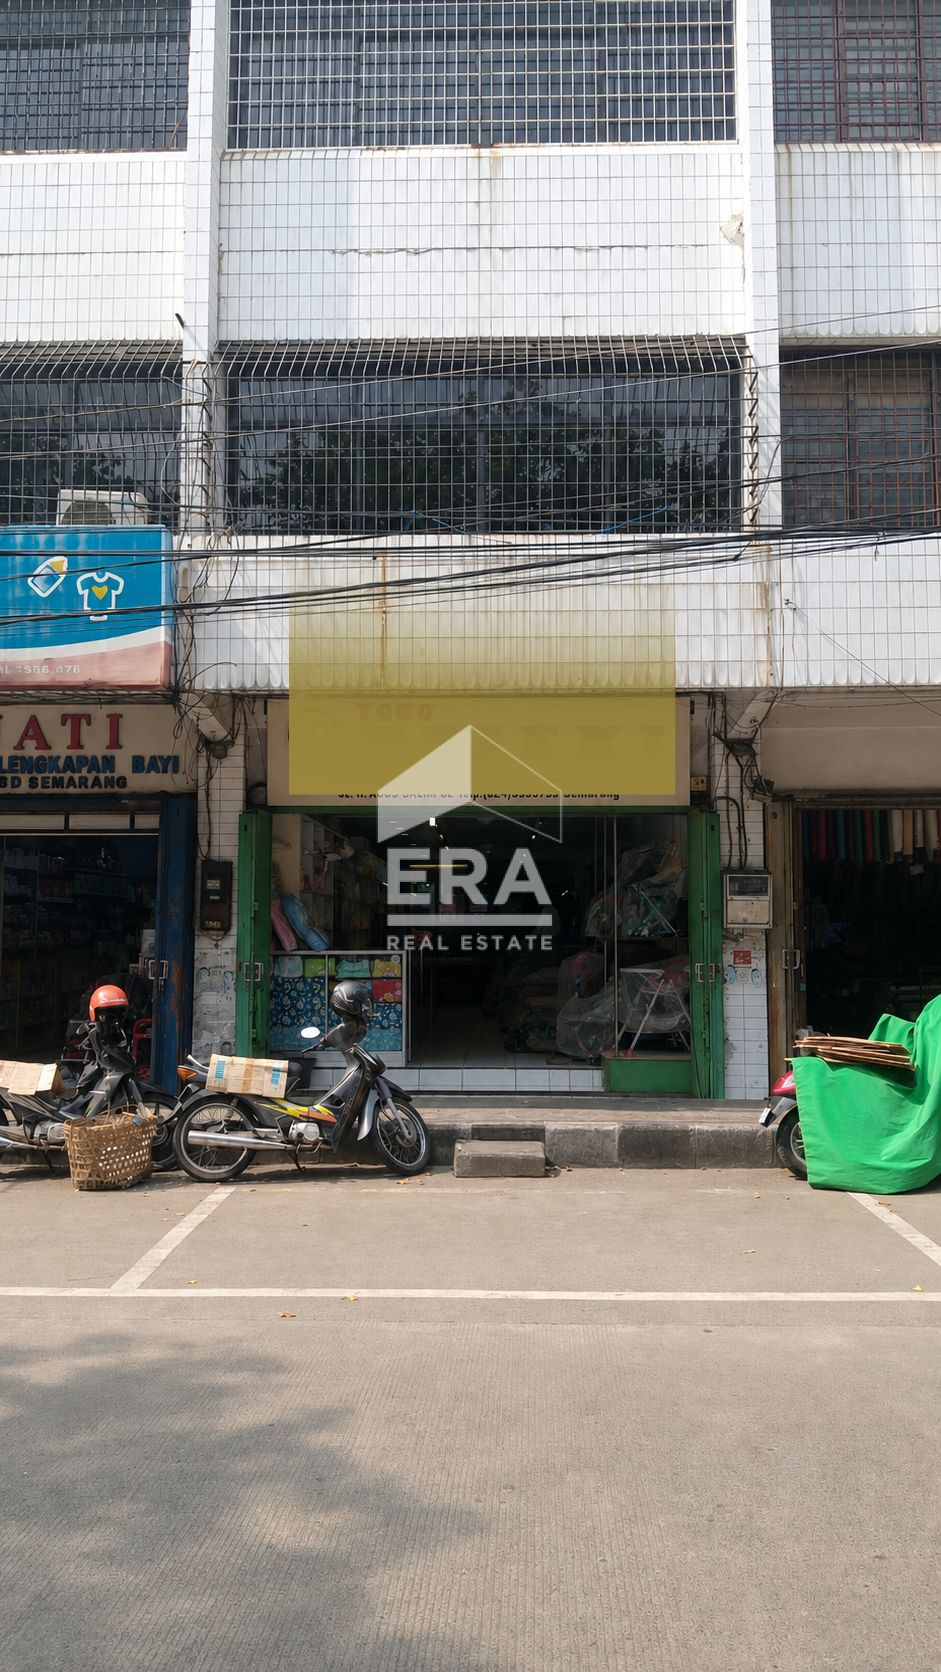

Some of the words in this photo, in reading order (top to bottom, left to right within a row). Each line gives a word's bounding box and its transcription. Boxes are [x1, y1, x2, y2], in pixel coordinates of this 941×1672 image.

[0, 713, 124, 751] ATI
[131, 755, 181, 774] BAYI
[28, 776, 128, 789] SEMARANG
